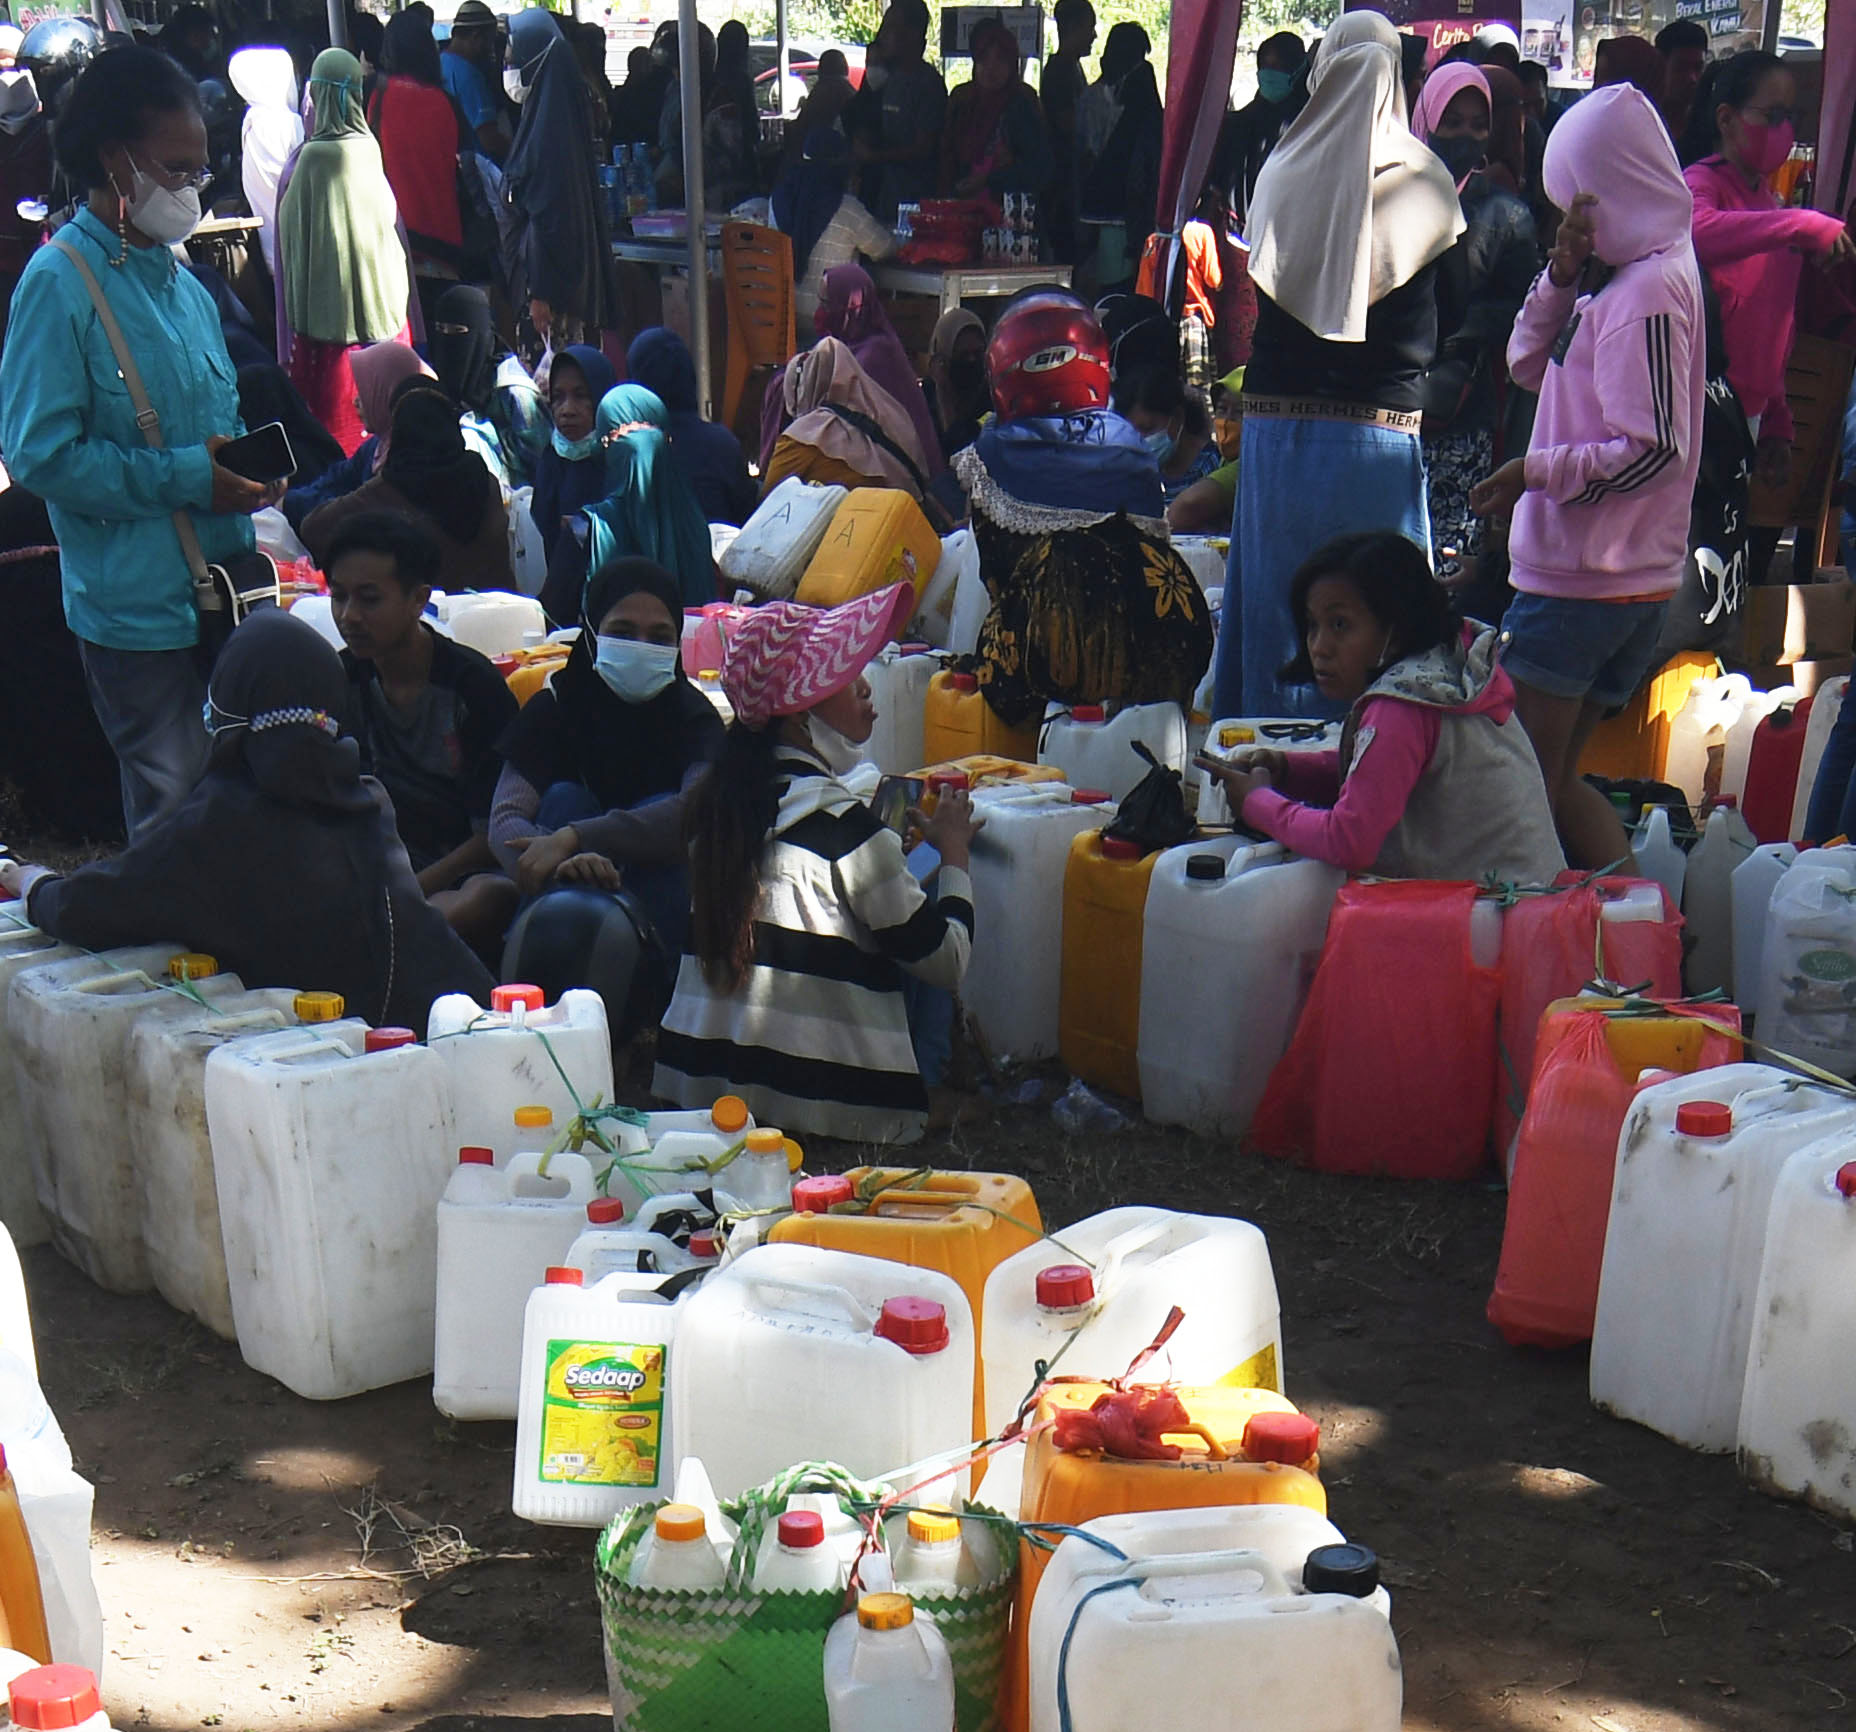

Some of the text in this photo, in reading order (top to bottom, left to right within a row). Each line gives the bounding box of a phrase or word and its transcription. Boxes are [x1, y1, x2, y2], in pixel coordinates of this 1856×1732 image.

[1290, 402, 1376, 420] HERMES
[761, 501, 792, 528] A
[833, 517, 855, 547] A
[564, 1363, 646, 1392] Sedaap
